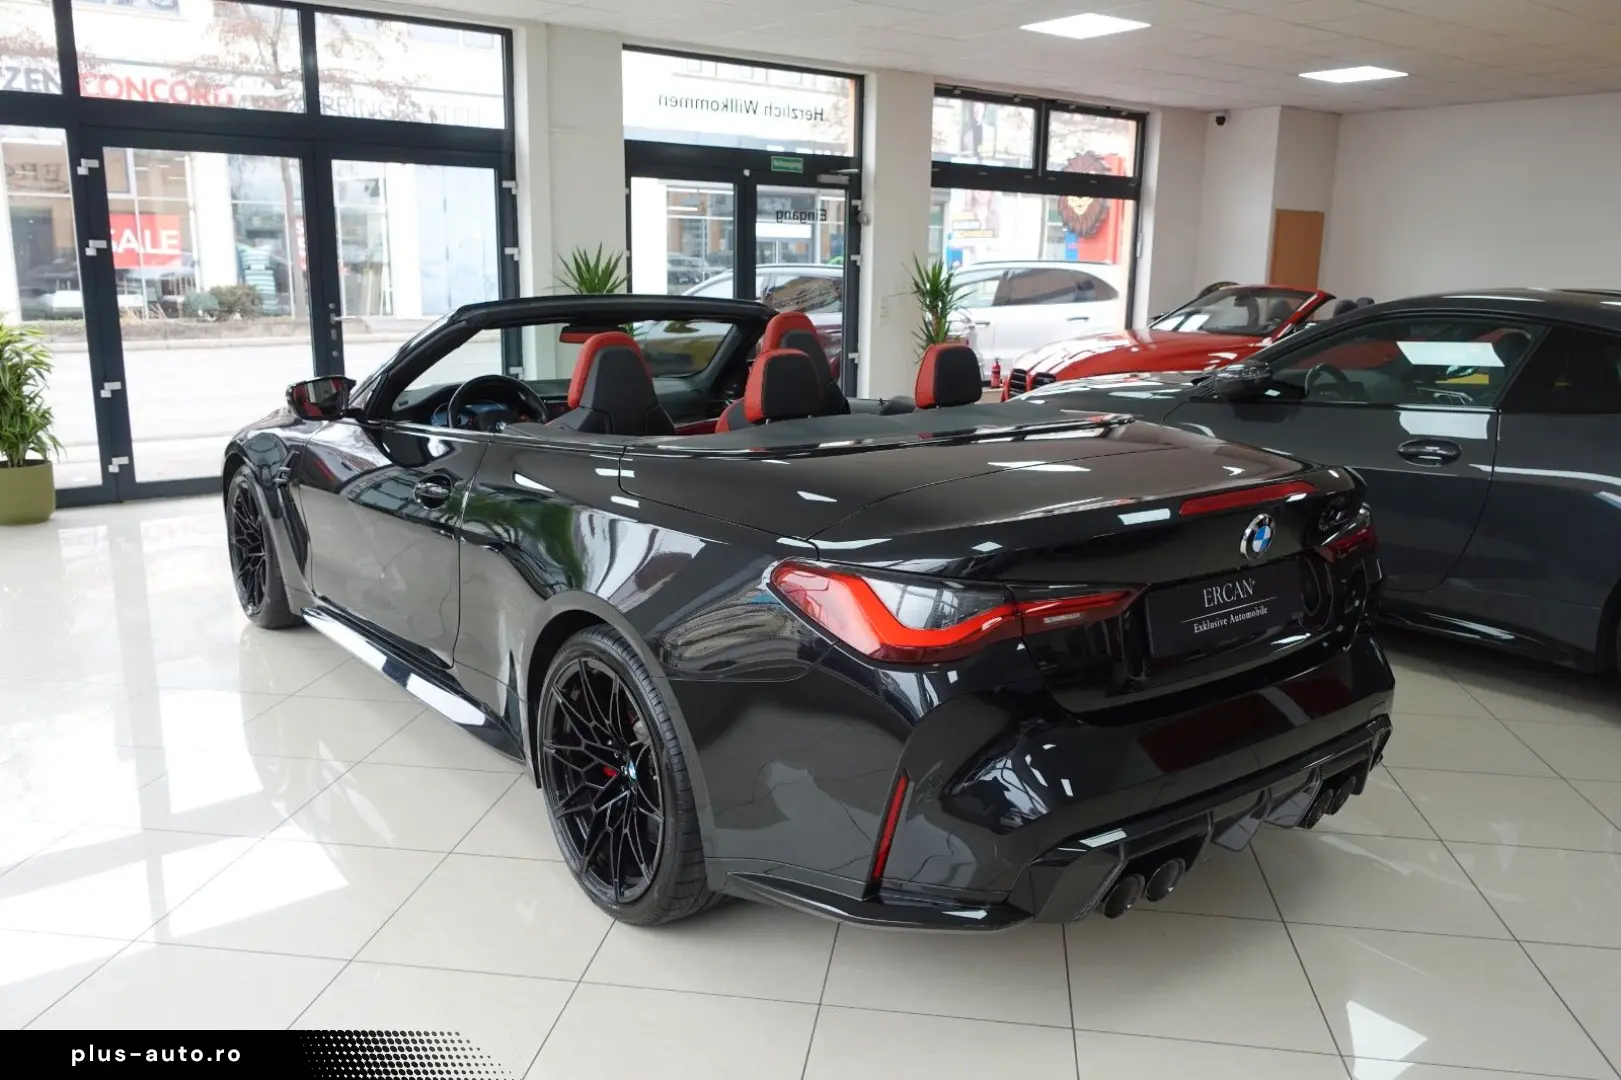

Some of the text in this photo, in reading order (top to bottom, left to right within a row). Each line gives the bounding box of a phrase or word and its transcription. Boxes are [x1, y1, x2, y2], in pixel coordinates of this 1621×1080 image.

[1203, 578, 1254, 608] ERCAN
[1193, 605, 1268, 634] Exklusive Automobile
